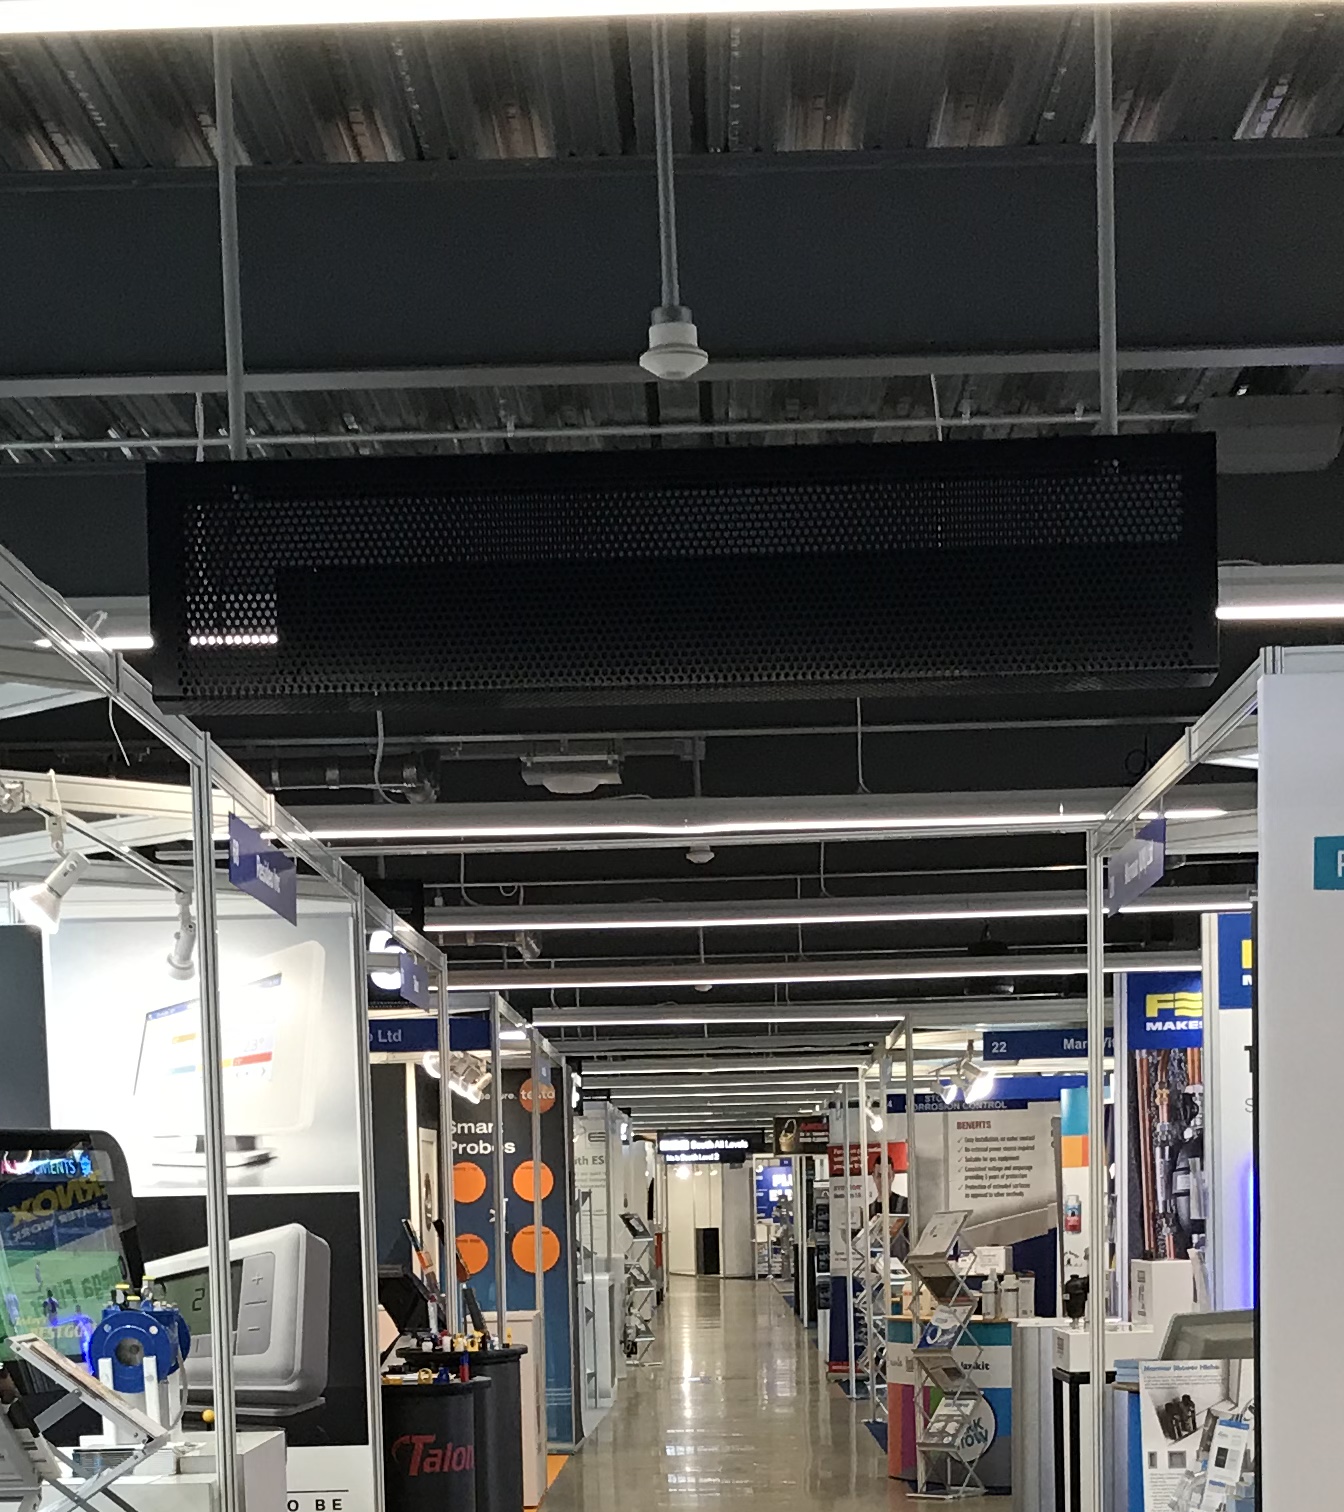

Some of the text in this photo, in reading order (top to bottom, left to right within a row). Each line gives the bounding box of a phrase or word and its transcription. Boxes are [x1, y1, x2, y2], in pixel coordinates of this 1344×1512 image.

[377, 1029, 402, 1043] Ltd
[991, 1038, 1088, 1053] 22 Mar
[520, 1089, 555, 1100] teto
[905, 1101, 1008, 1111] ORROSION CONTROL
[451, 1139, 516, 1155] Probs
[391, 1434, 475, 1476] Talon
[287, 1498, 343, 1512] O BE
